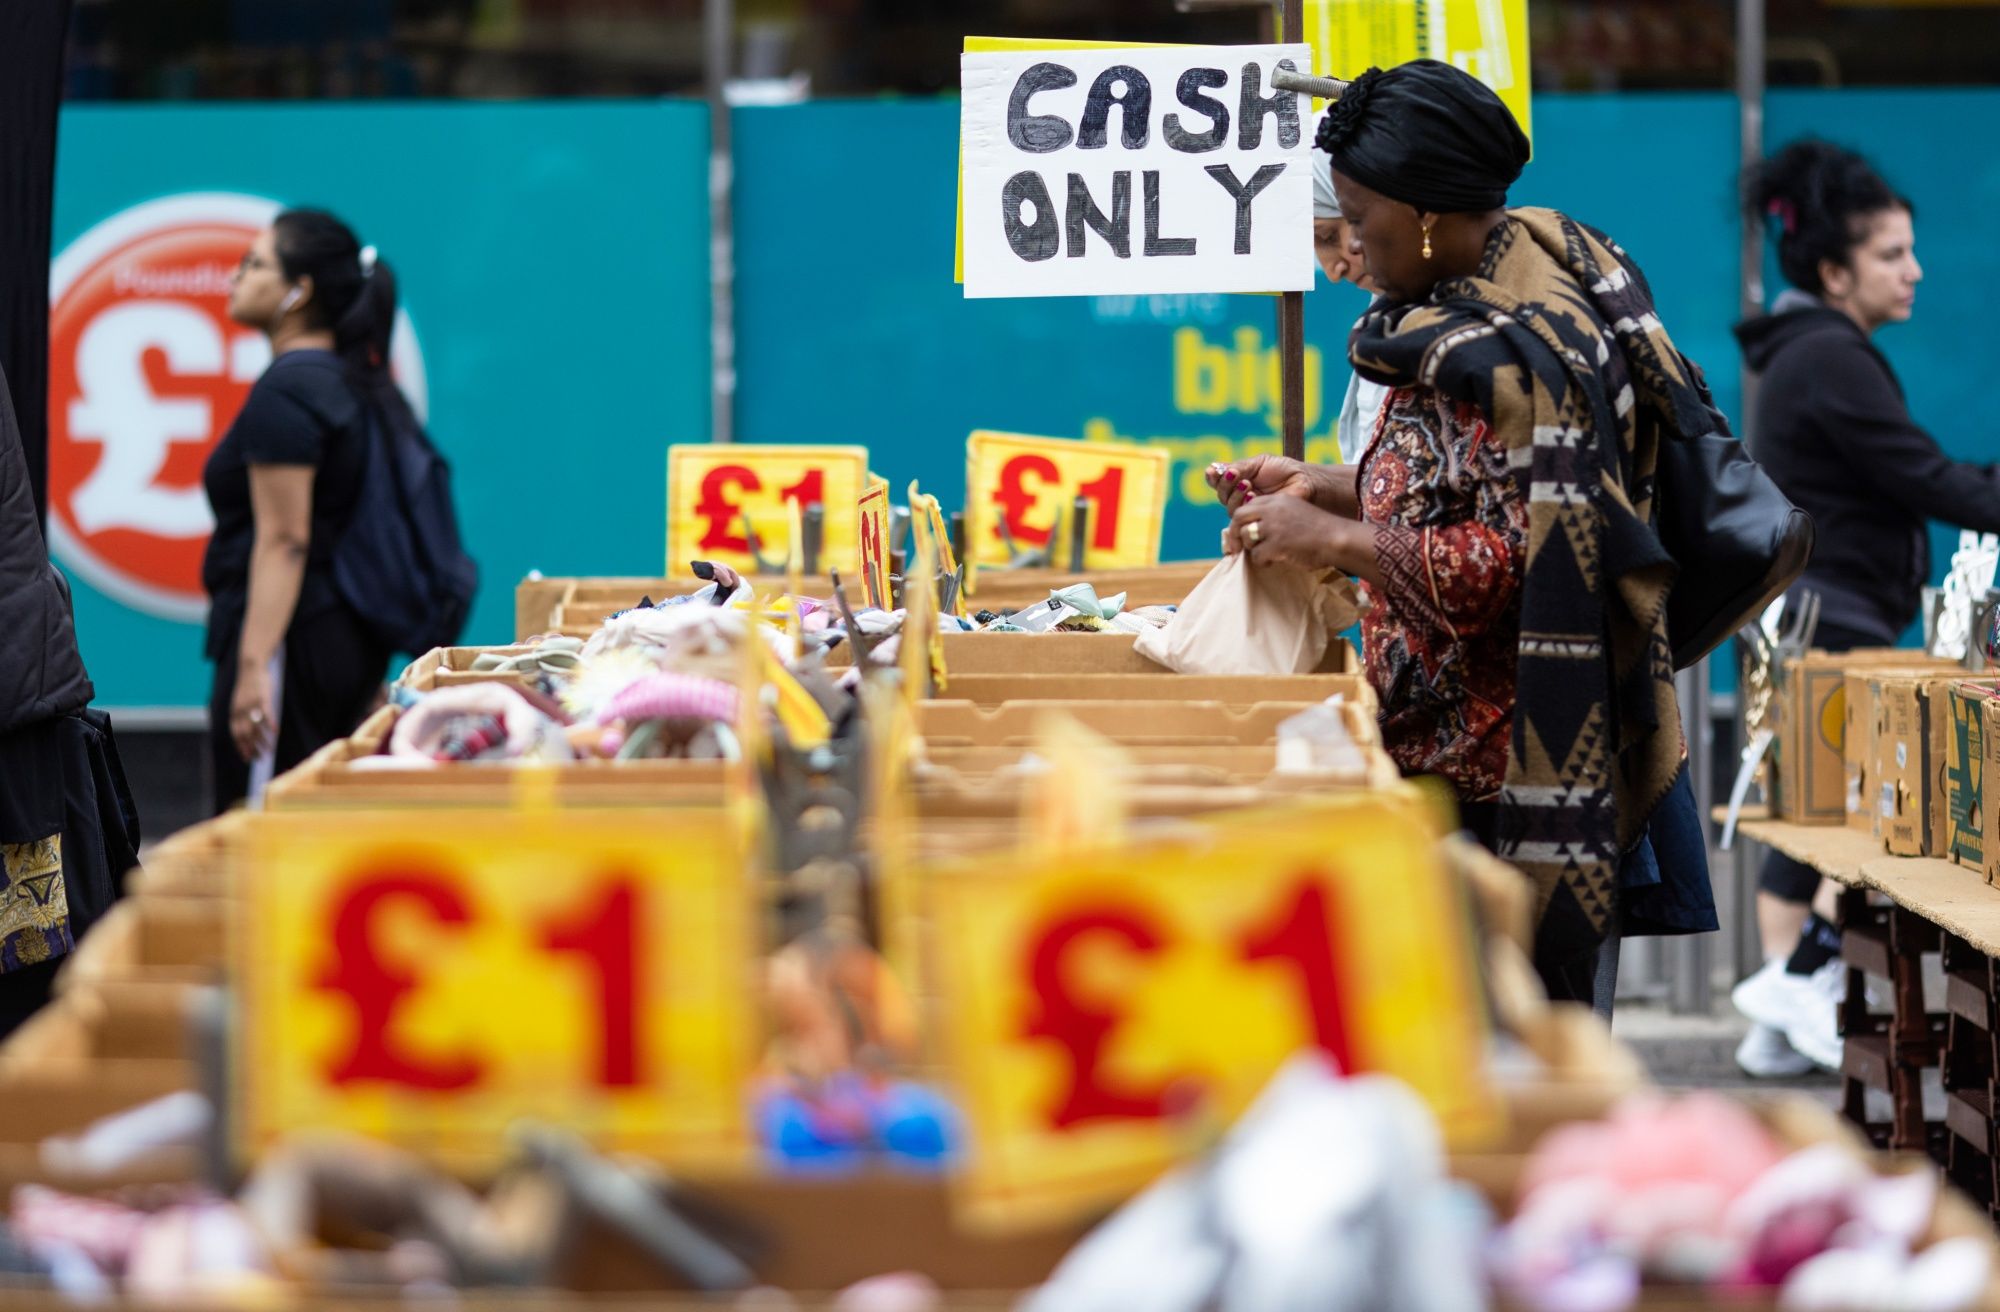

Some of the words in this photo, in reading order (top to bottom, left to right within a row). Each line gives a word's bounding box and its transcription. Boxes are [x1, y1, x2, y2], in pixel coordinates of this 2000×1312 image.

[1007, 58, 1301, 153] CASH
[1002, 163, 1288, 262] ONLY
[1172, 325, 1323, 433] big
[992, 454, 1122, 552] £1
[312, 864, 648, 1096] £1
[1018, 872, 1366, 1132] £1
